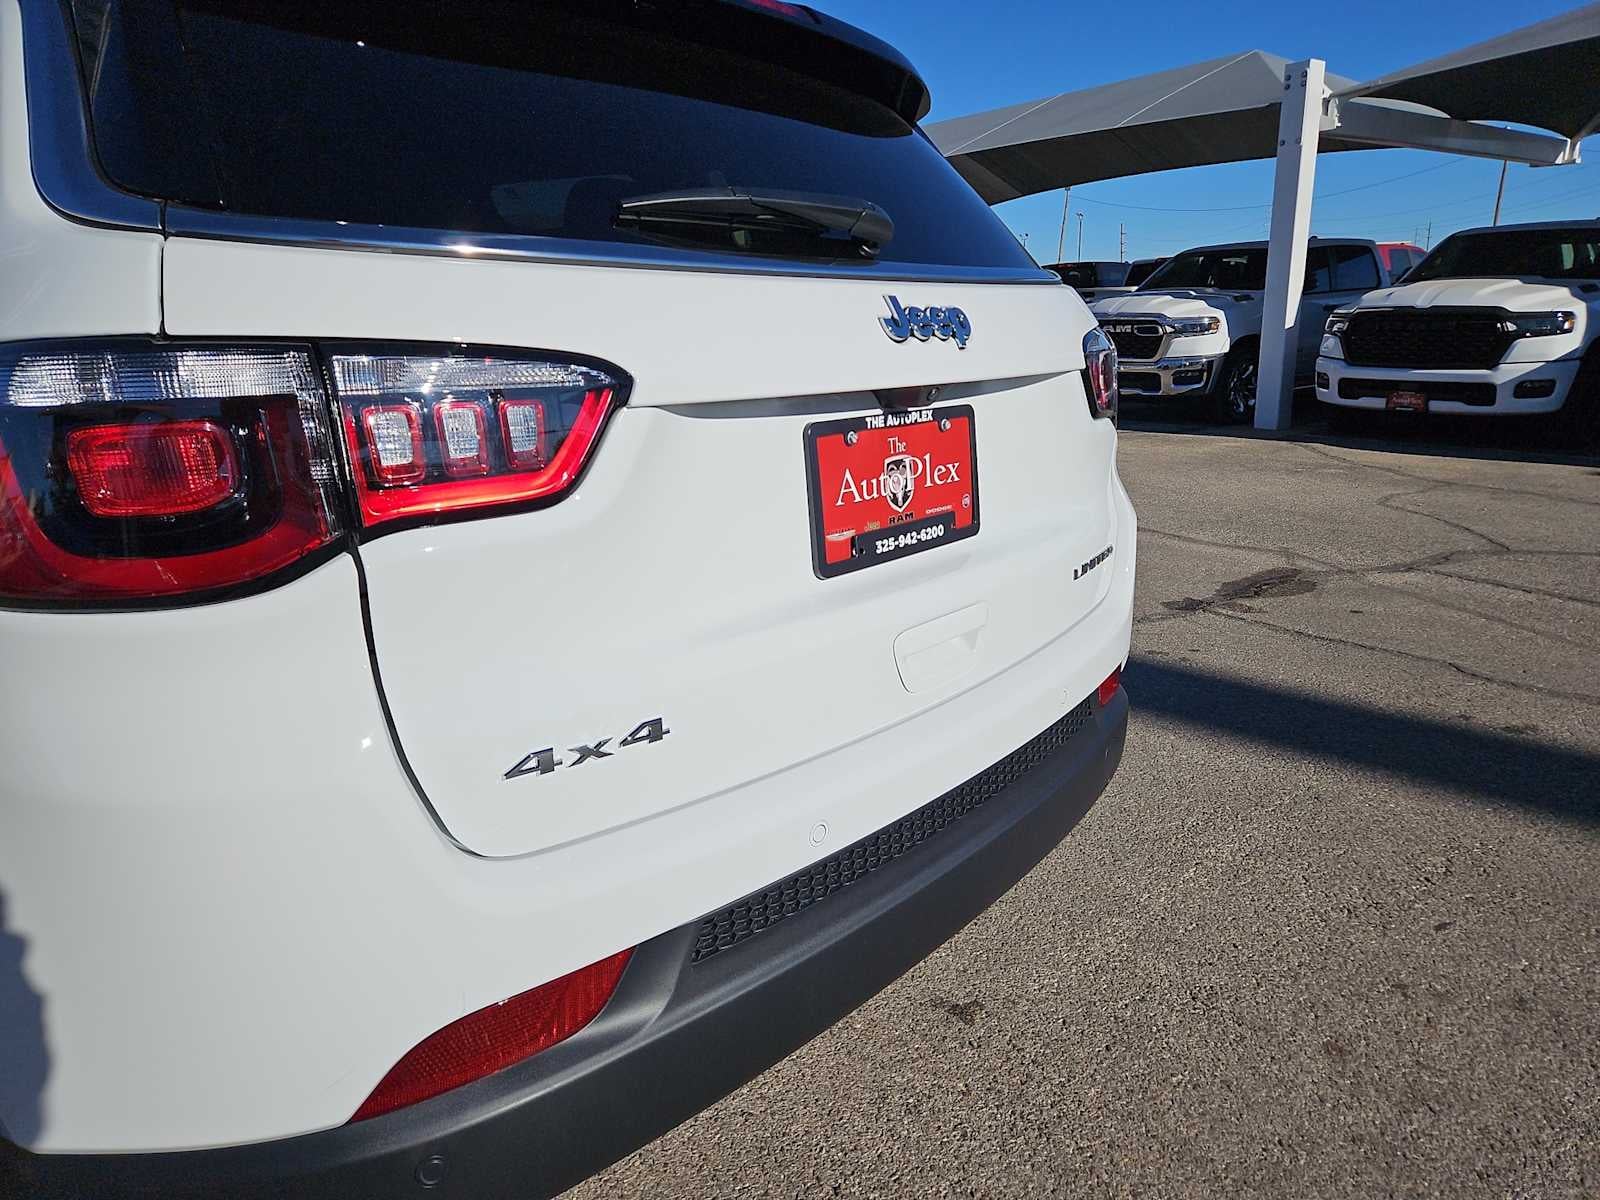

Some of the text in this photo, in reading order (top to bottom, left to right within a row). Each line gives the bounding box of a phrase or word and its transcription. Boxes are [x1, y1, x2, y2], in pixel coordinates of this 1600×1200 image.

[878, 295, 971, 350] Jeep
[865, 410, 933, 429] THE AUTOPLEX
[888, 436, 906, 454] The
[889, 512, 914, 525] RAM
[876, 524, 944, 554] 325-942-6200
[502, 717, 670, 780] 4x4
